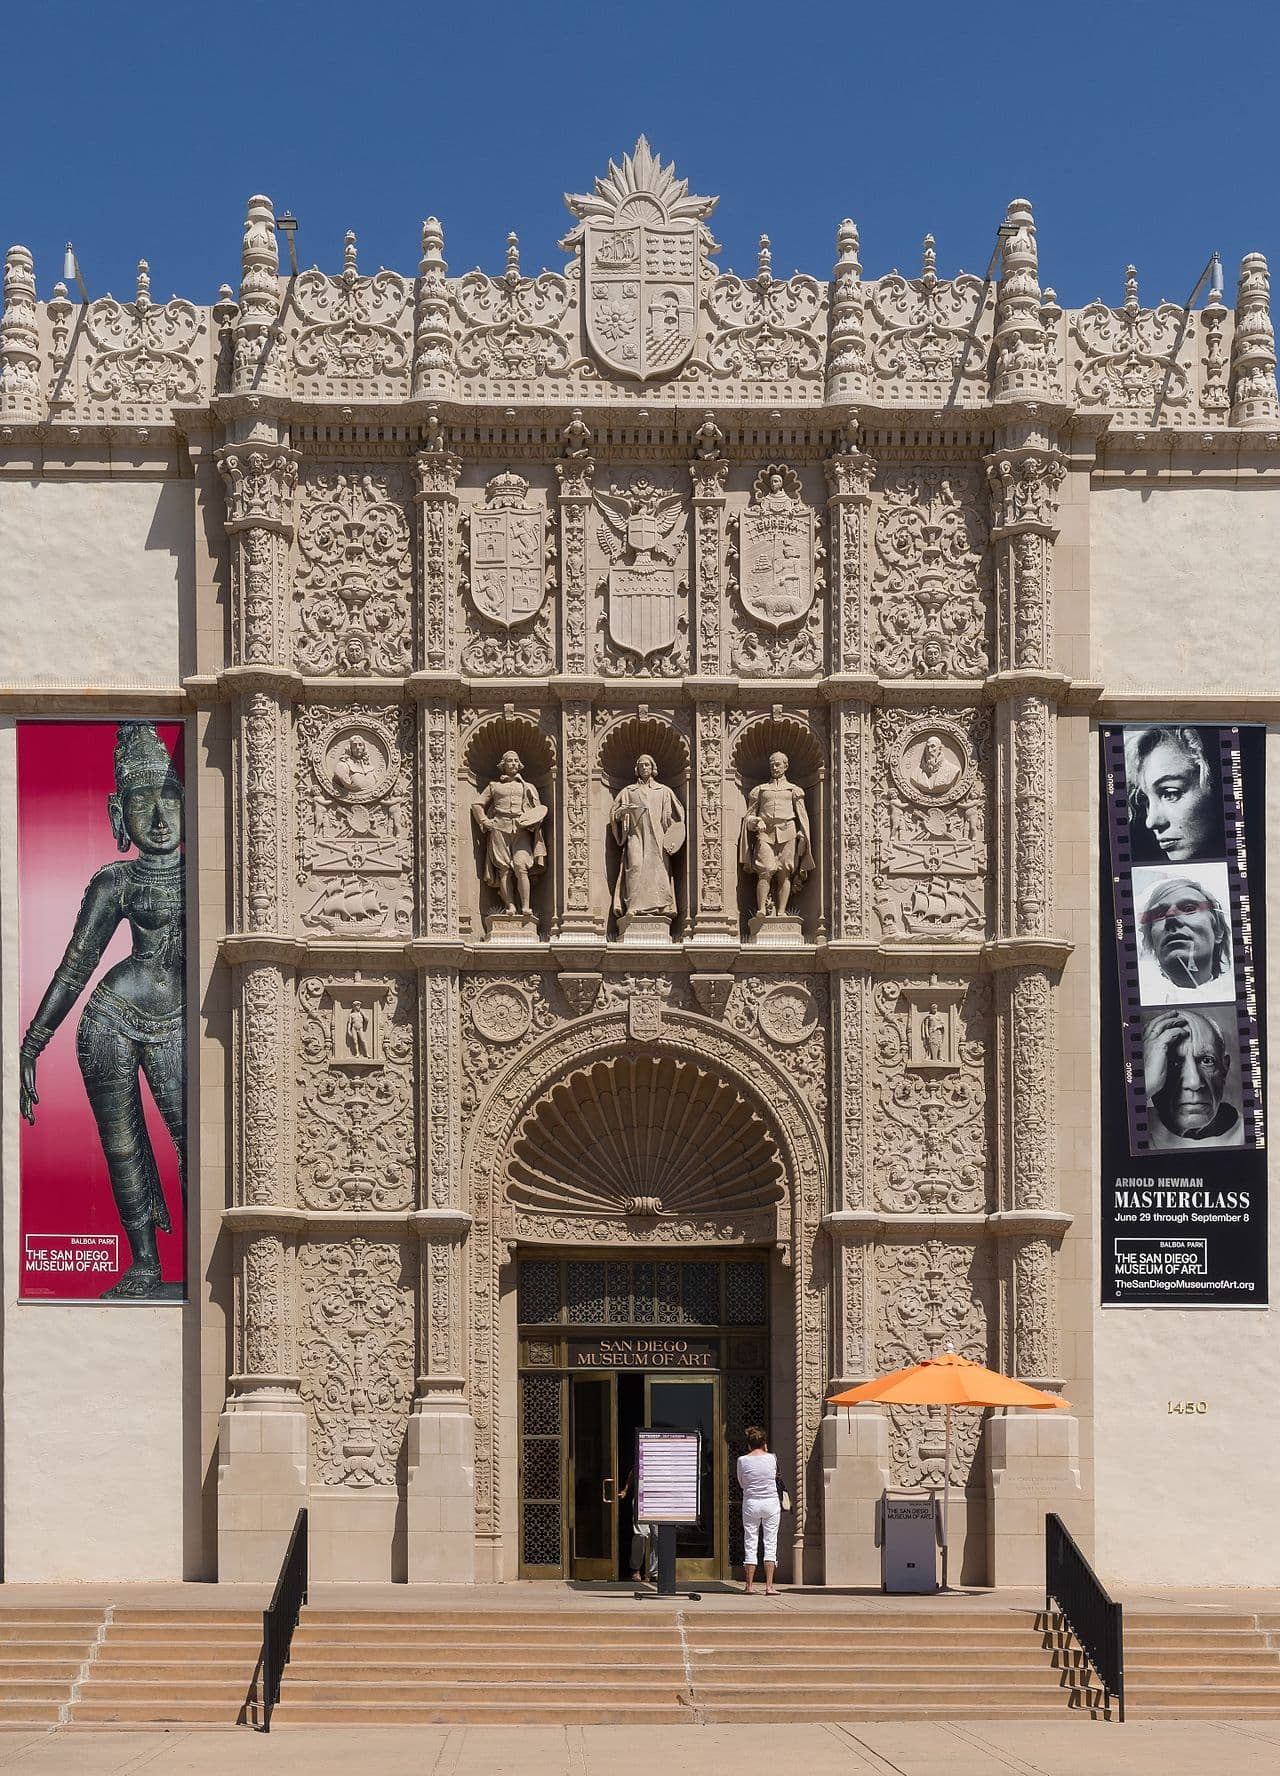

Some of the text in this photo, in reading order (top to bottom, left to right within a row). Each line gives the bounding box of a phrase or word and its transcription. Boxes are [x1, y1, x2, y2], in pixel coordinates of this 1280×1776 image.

[1240, 871, 1248, 879] 8
[1125, 1062, 1133, 1084] 400UC
[1115, 1177, 1204, 1188] ARNOLD NEWMAN
[1114, 1191, 1251, 1209] MASTERCLASS
[1114, 1212, 1250, 1224] June 29 through September 8
[26, 1250, 109, 1262] THE SAN DIEGO
[1115, 1253, 1198, 1264] THE SAN DIEGO
[26, 1261, 114, 1272] MUSEUM OF ART
[1115, 1264, 1203, 1275] MUSEUM OF ART
[1115, 1280, 1255, 1291] TheSanDiegoMuseumofArt.org
[600, 1340, 688, 1353] SAN DIEGO
[577, 1353, 711, 1366] MUSEUM OF ART
[1167, 1400, 1207, 1415] 1450
